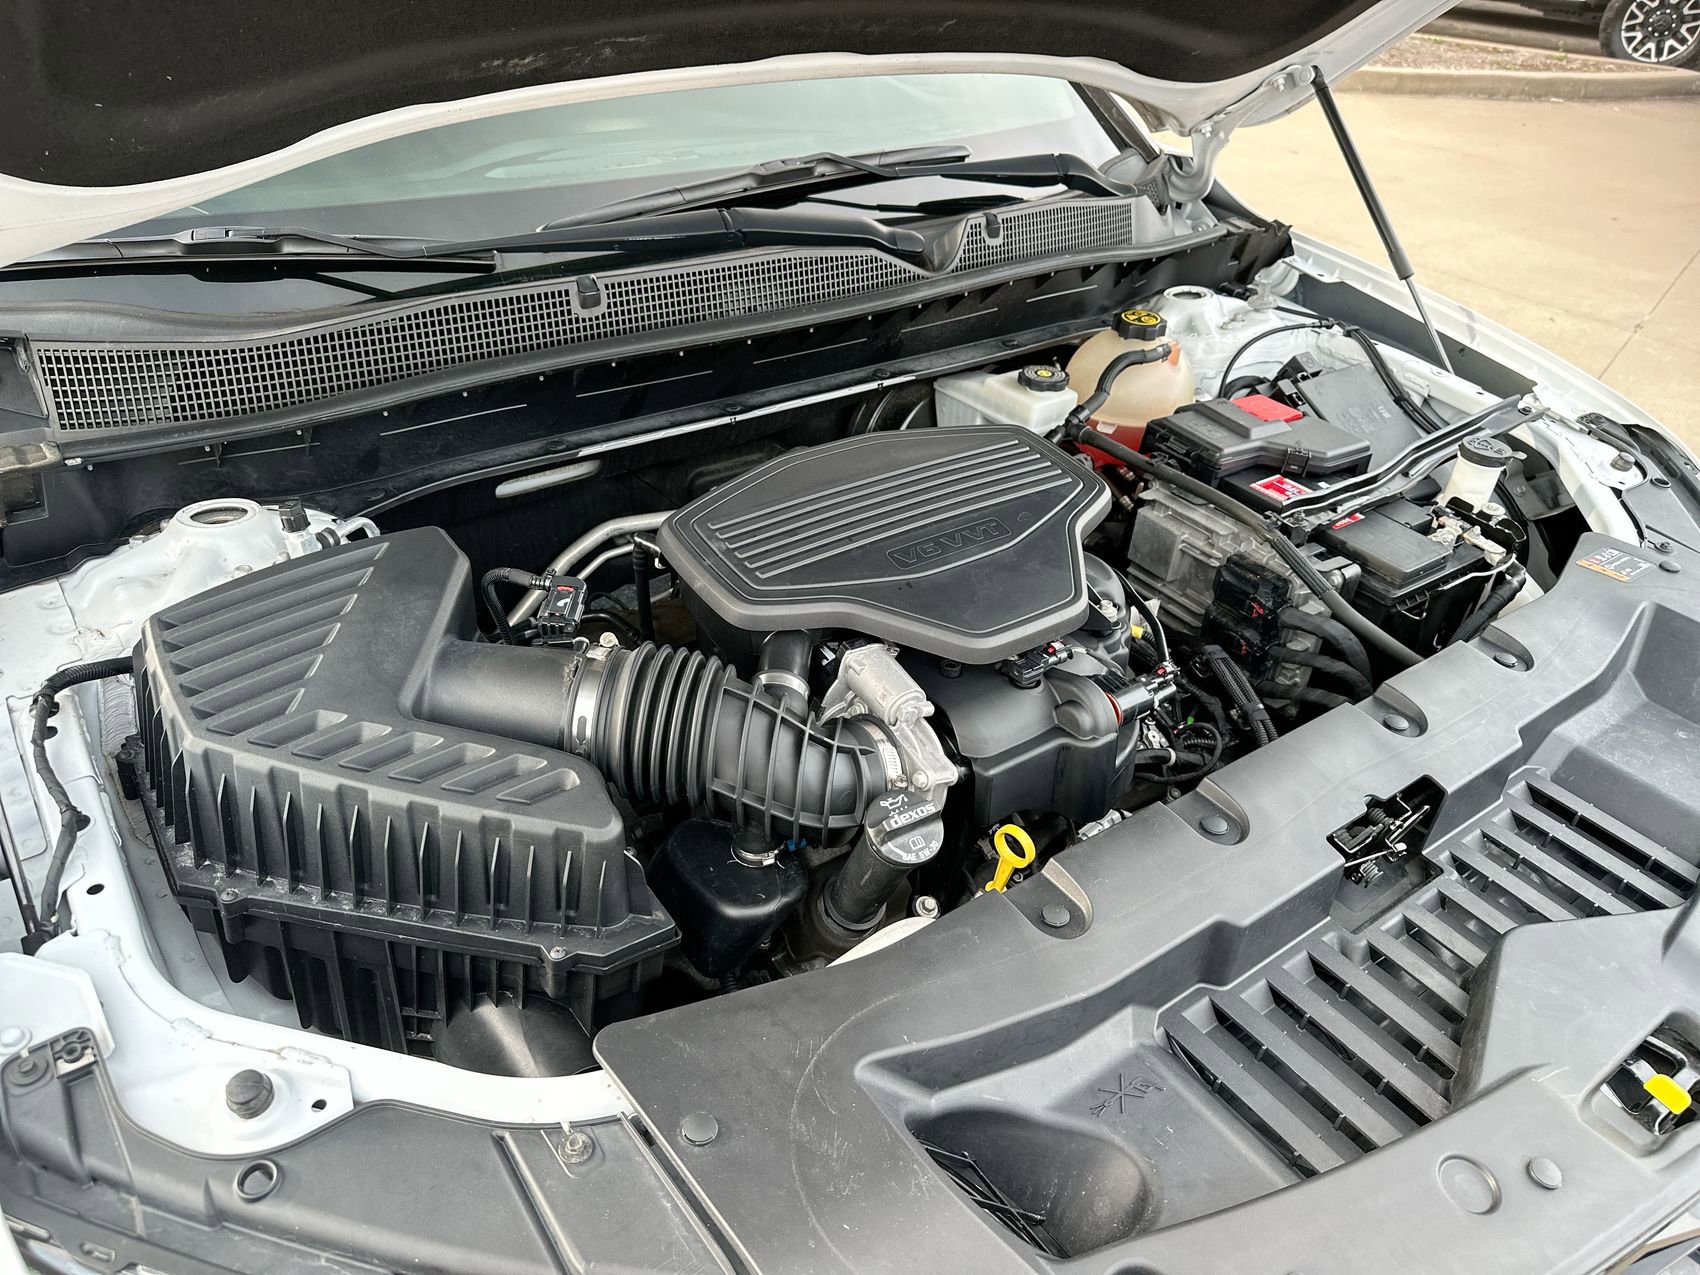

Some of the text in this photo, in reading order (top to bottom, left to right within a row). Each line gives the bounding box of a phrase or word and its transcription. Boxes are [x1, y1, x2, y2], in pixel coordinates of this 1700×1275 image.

[893, 522, 1000, 563] V6 VVT
[890, 803, 936, 828] dexos
